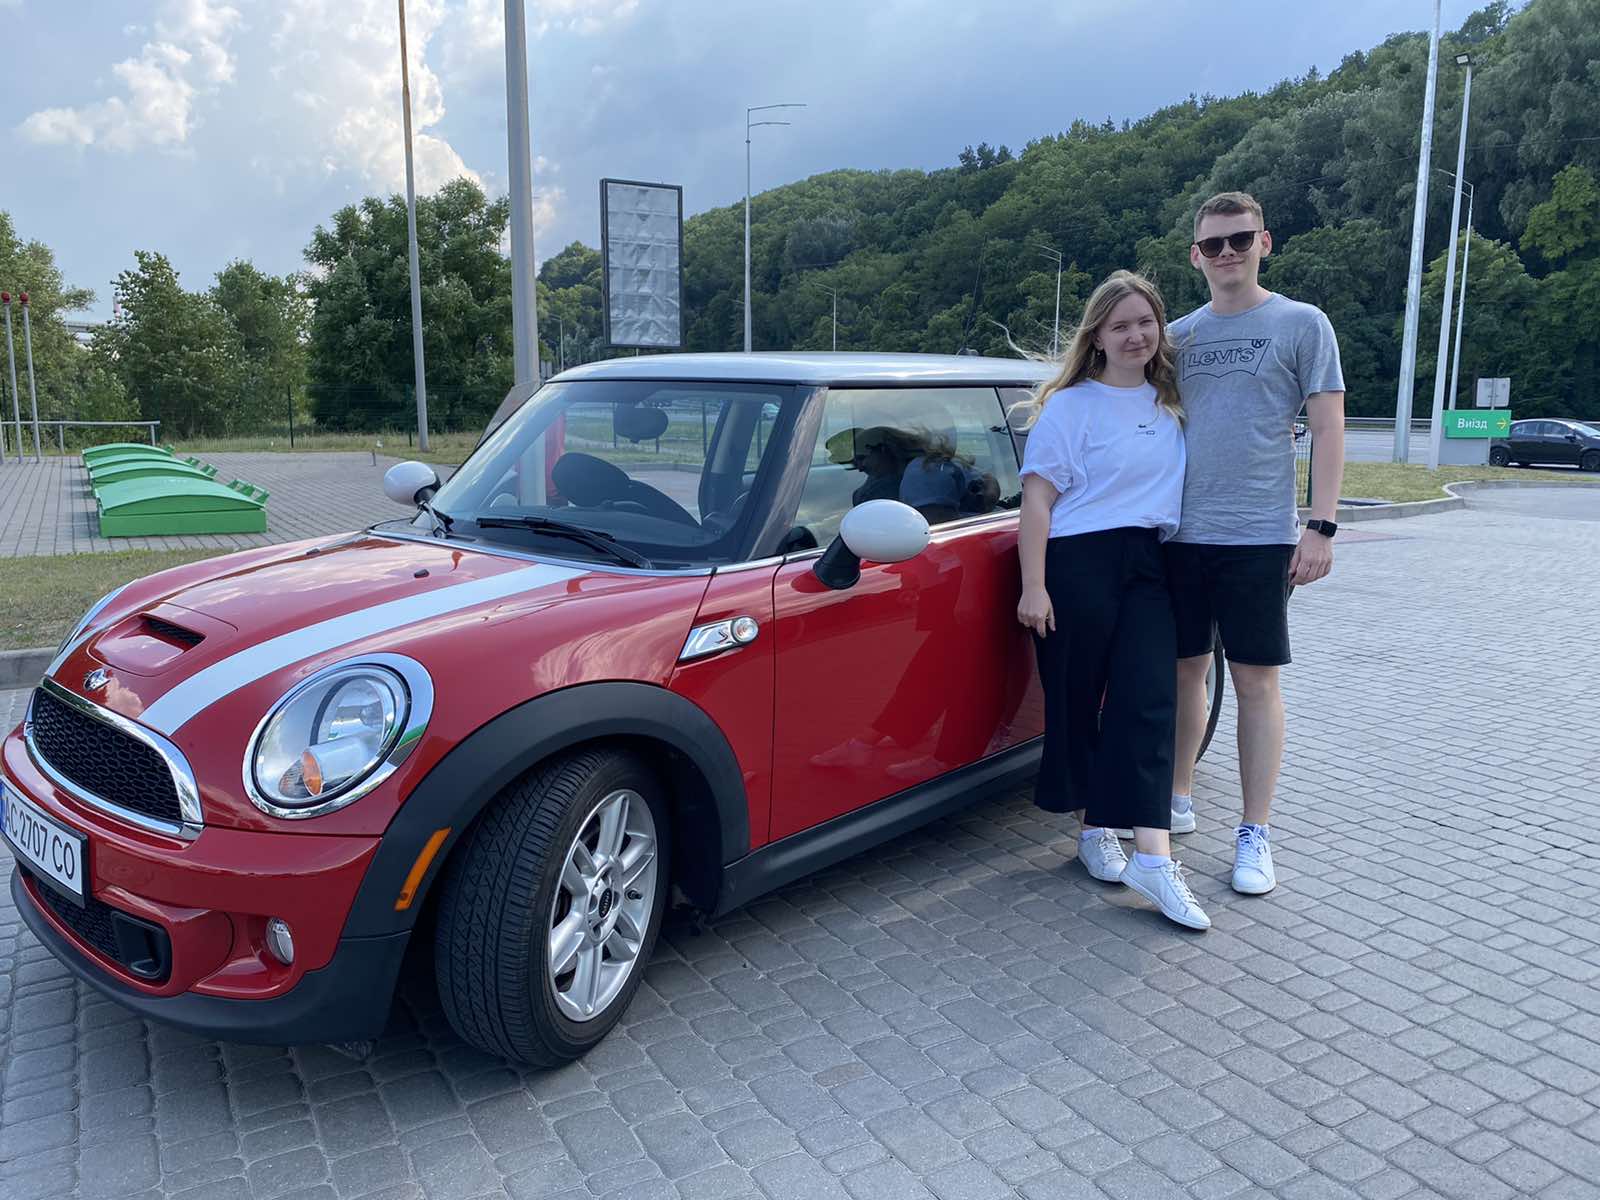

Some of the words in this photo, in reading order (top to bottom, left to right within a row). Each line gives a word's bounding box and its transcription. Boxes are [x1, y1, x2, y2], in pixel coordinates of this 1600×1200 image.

[1457, 417, 1488, 430] Виїзд
[4, 796, 18, 838] AC
[20, 810, 48, 861] 2707
[52, 834, 75, 880] CO
